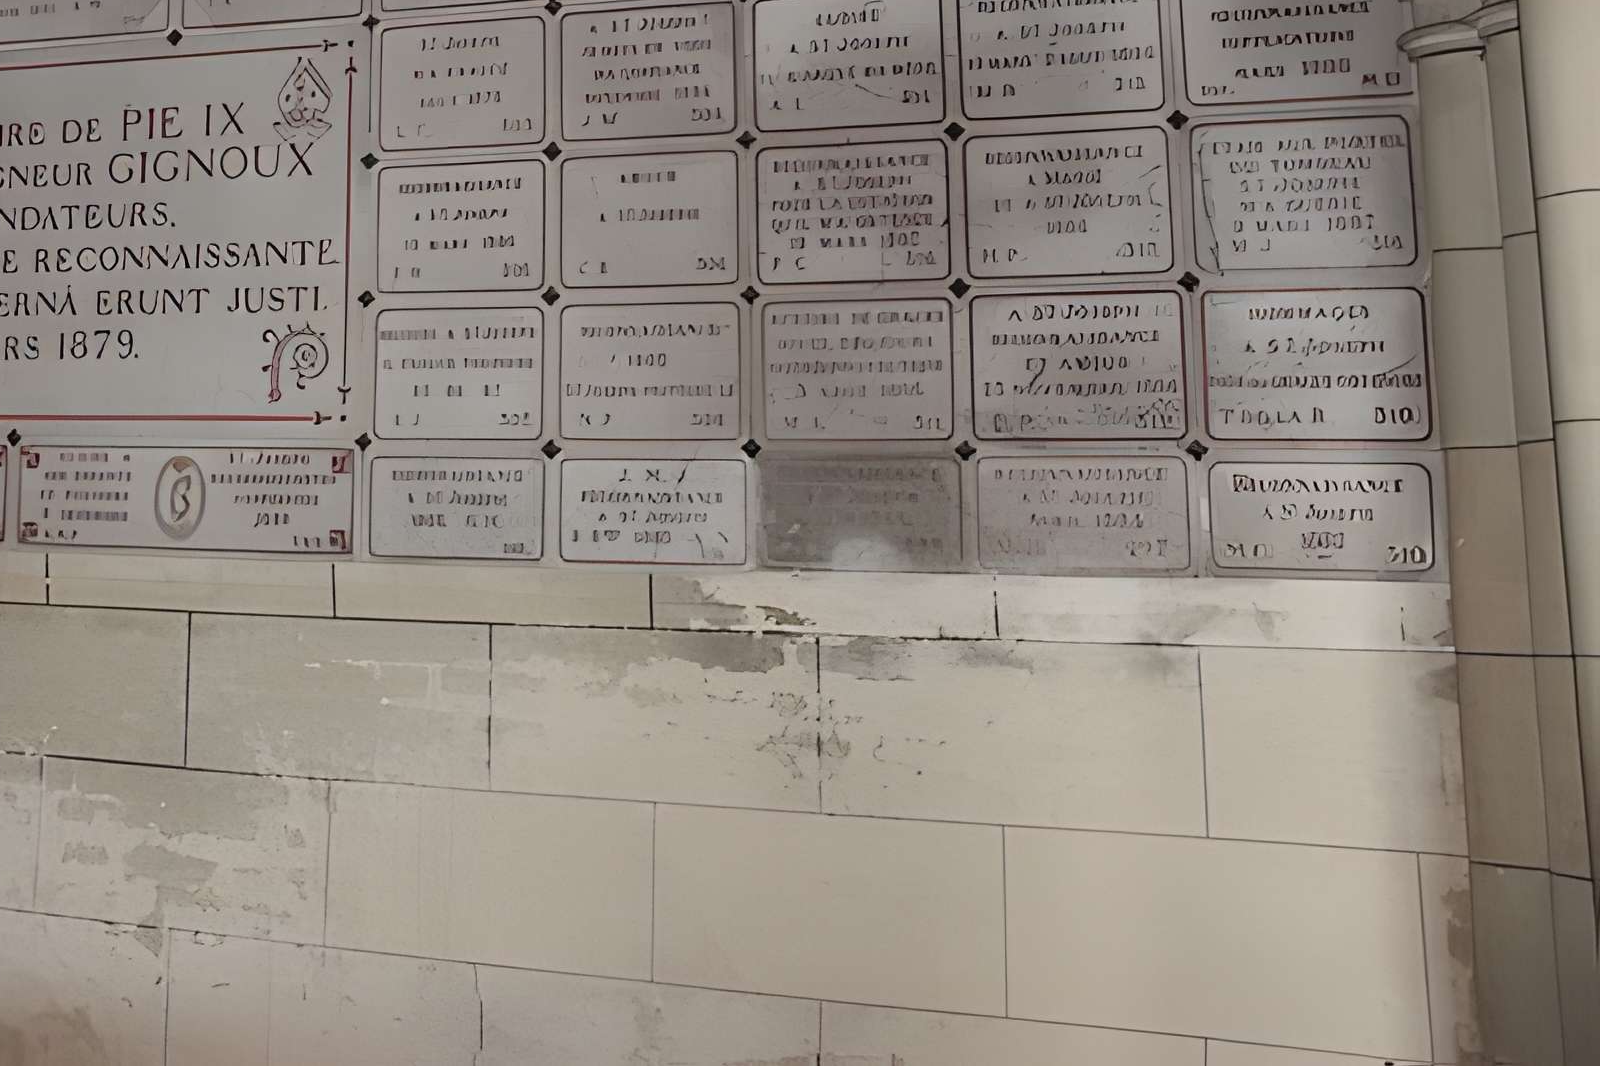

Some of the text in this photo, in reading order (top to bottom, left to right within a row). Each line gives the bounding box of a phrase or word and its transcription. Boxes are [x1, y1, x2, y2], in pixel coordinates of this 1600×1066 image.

[62, 118, 102, 144] DE
[122, 106, 183, 141] PIE
[204, 101, 245, 137] IX
[108, 142, 314, 184] GIGNOUX
[34, 238, 341, 273] RECONNAISSANTE
[96, 287, 210, 316] ERUNT
[227, 285, 328, 314] JUSTI.
[59, 329, 139, 360] 1879.
